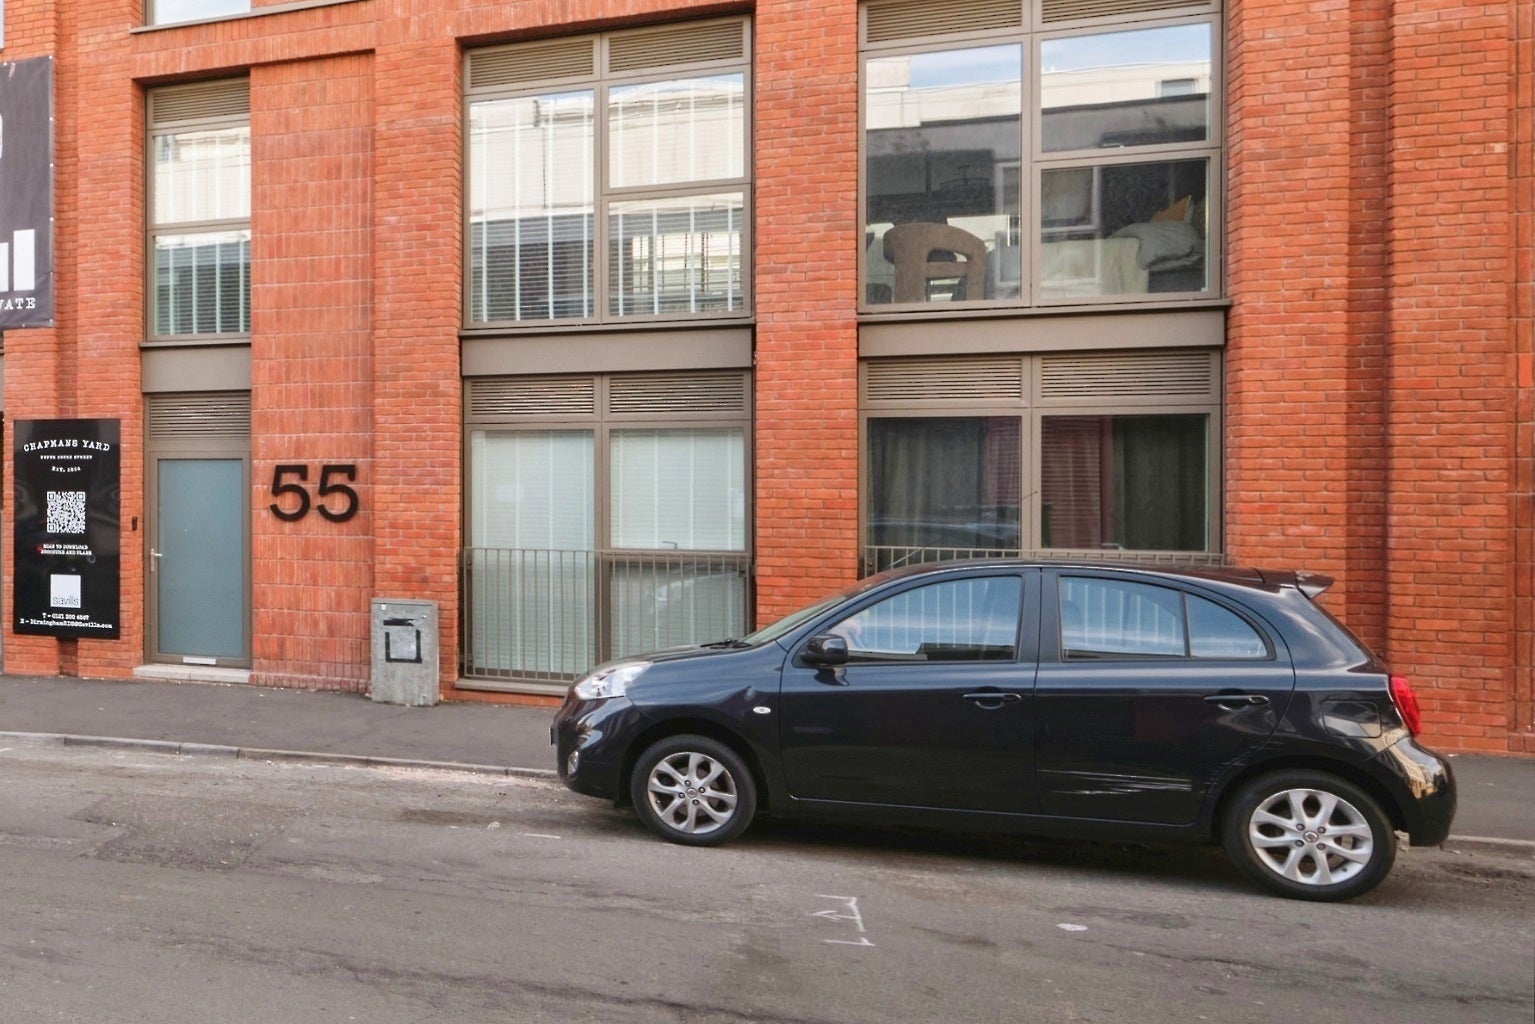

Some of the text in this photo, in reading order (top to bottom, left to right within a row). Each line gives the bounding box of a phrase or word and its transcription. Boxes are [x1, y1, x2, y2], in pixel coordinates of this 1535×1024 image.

[24, 439, 110, 452] CHAPMANS YARD
[269, 464, 359, 523] 55
[52, 594, 79, 606] savills
